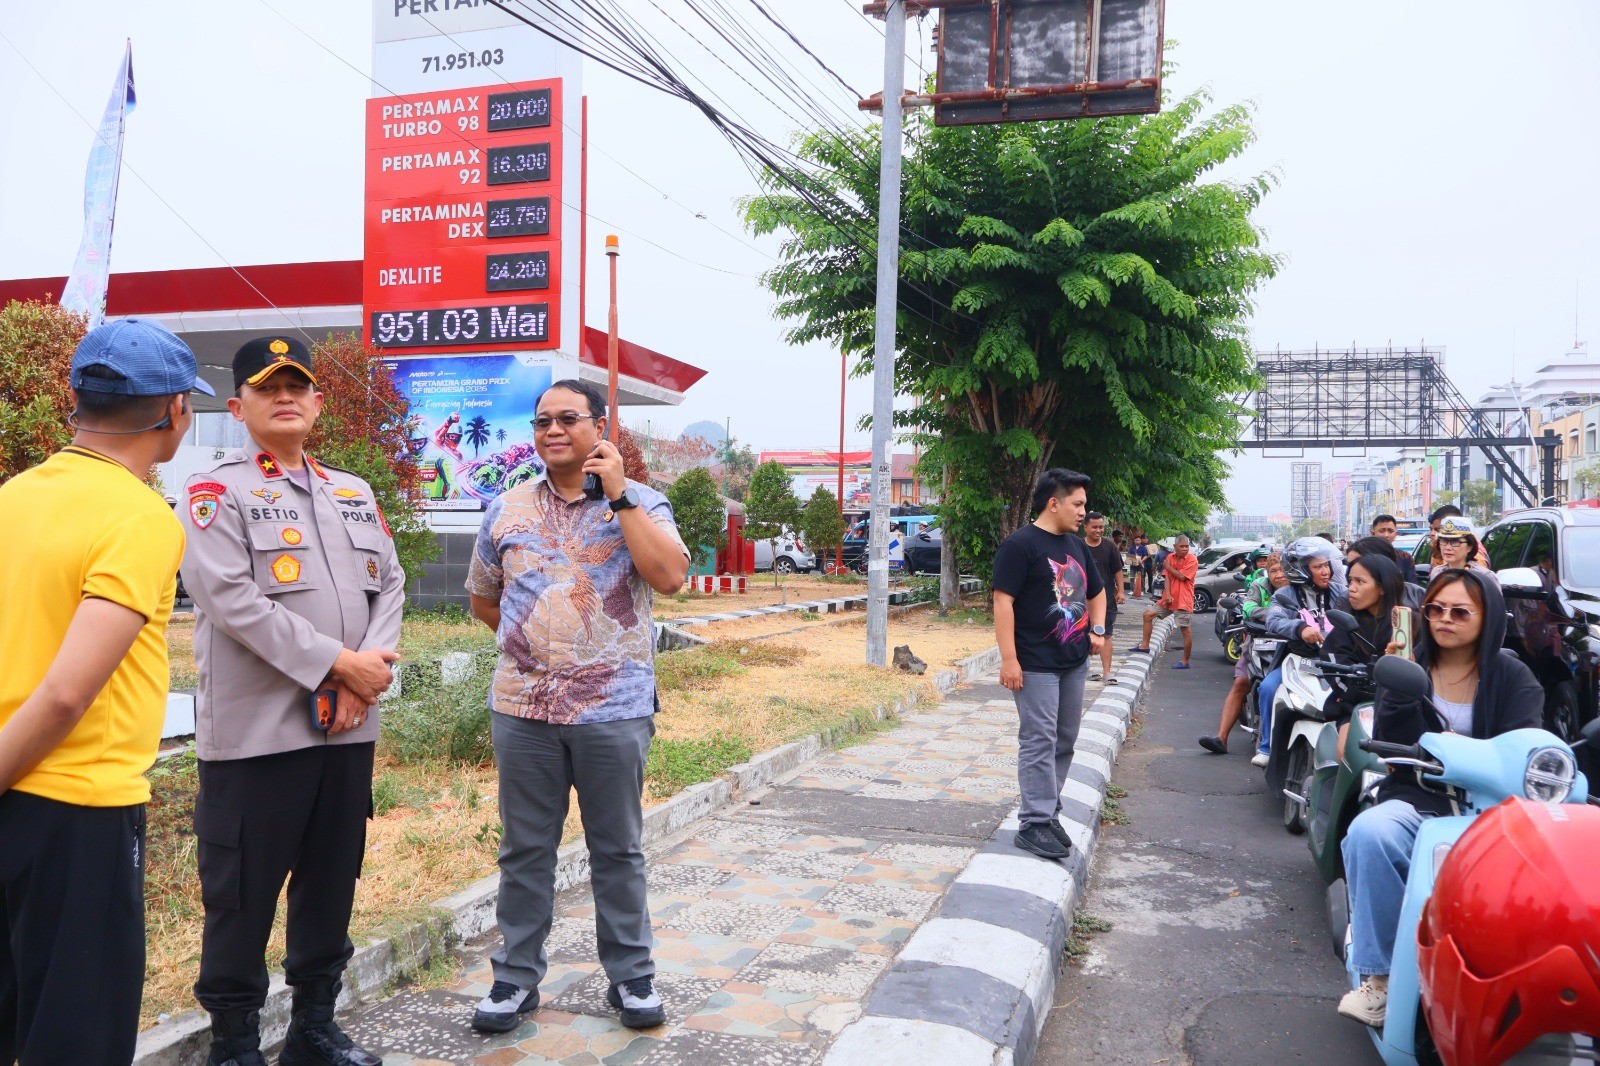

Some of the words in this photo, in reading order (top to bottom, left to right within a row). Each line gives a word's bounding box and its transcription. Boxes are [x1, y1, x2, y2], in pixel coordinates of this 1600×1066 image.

[422, 48, 504, 74] 71.951.03
[382, 95, 480, 121] PERTAMAX
[490, 97, 548, 121] 20.000
[382, 120, 442, 139] TURBO
[457, 116, 479, 132] 98
[382, 149, 480, 172] PERTAMAX
[491, 152, 547, 174] 16.300
[459, 168, 480, 185] 92
[381, 202, 484, 223] PERTAMINA
[448, 222, 484, 239] DEX
[379, 266, 442, 287] DEXLITE
[489, 260, 547, 281] 24.200
[412, 380, 459, 388] PERTAMINA
[423, 386, 465, 394] INDONESIA
[465, 385, 488, 393] 2026
[462, 398, 493, 411] Indonesia
[251, 508, 299, 521] SETIO
[342, 510, 377, 525] POLRI
